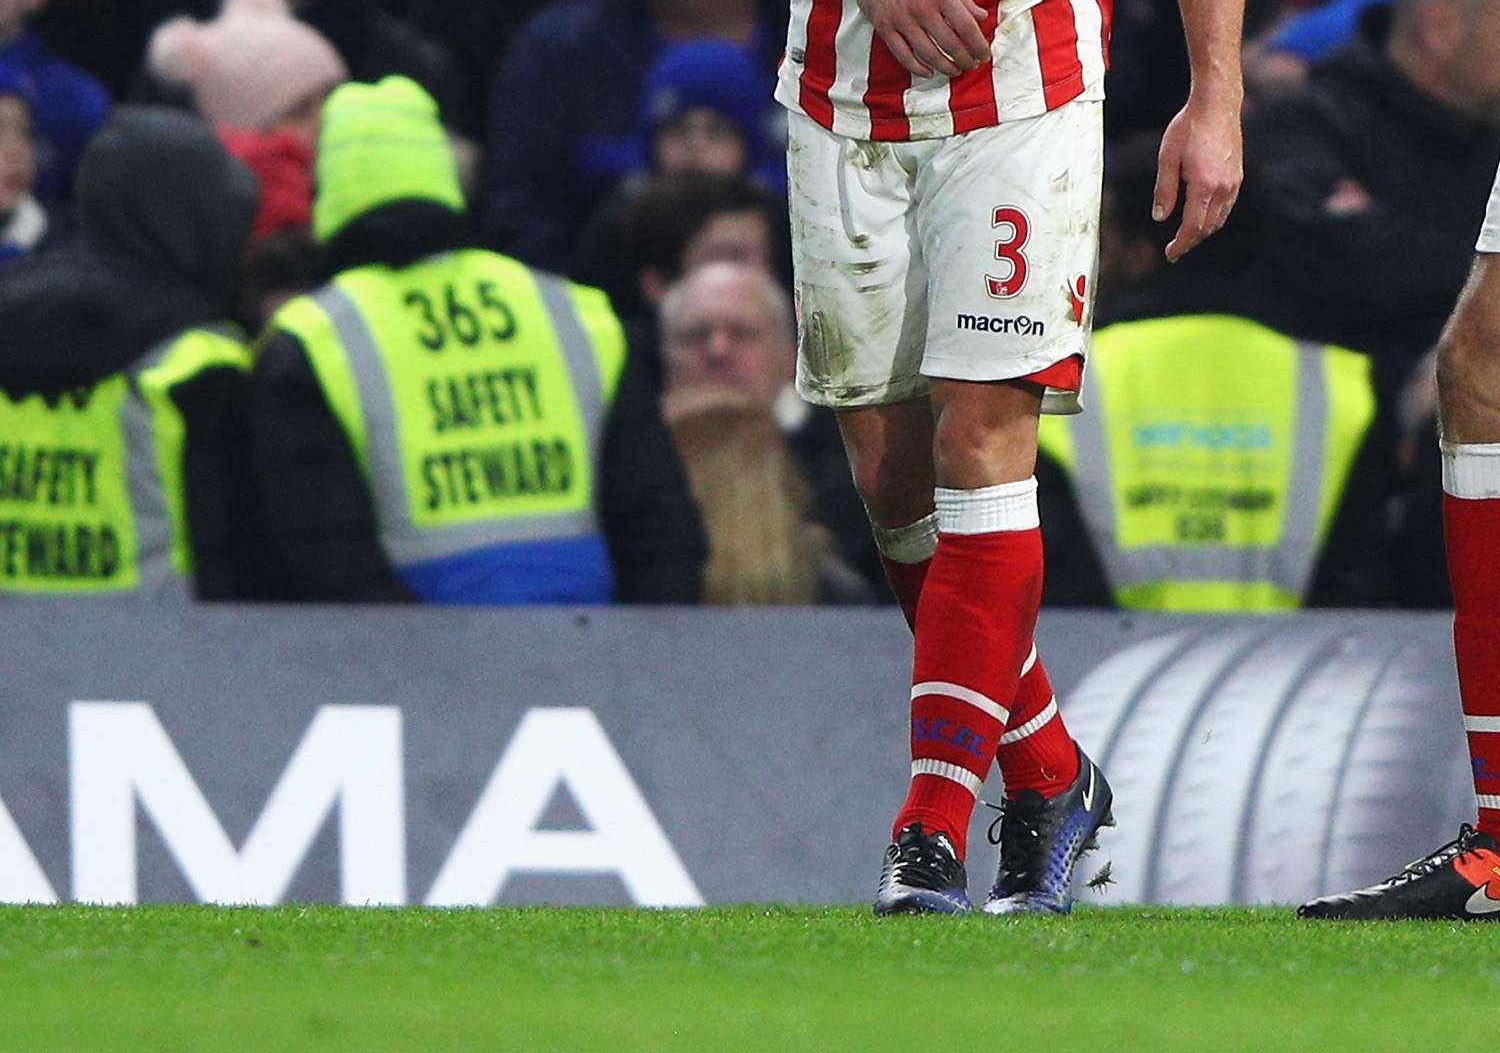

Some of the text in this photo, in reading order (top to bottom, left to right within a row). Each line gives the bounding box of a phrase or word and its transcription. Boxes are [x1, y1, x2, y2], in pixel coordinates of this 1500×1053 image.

[983, 204, 1032, 300] 3
[403, 279, 518, 351] 365
[956, 312, 1045, 338] macron
[425, 365, 544, 433] SAFETY
[421, 437, 575, 510] STEWARD
